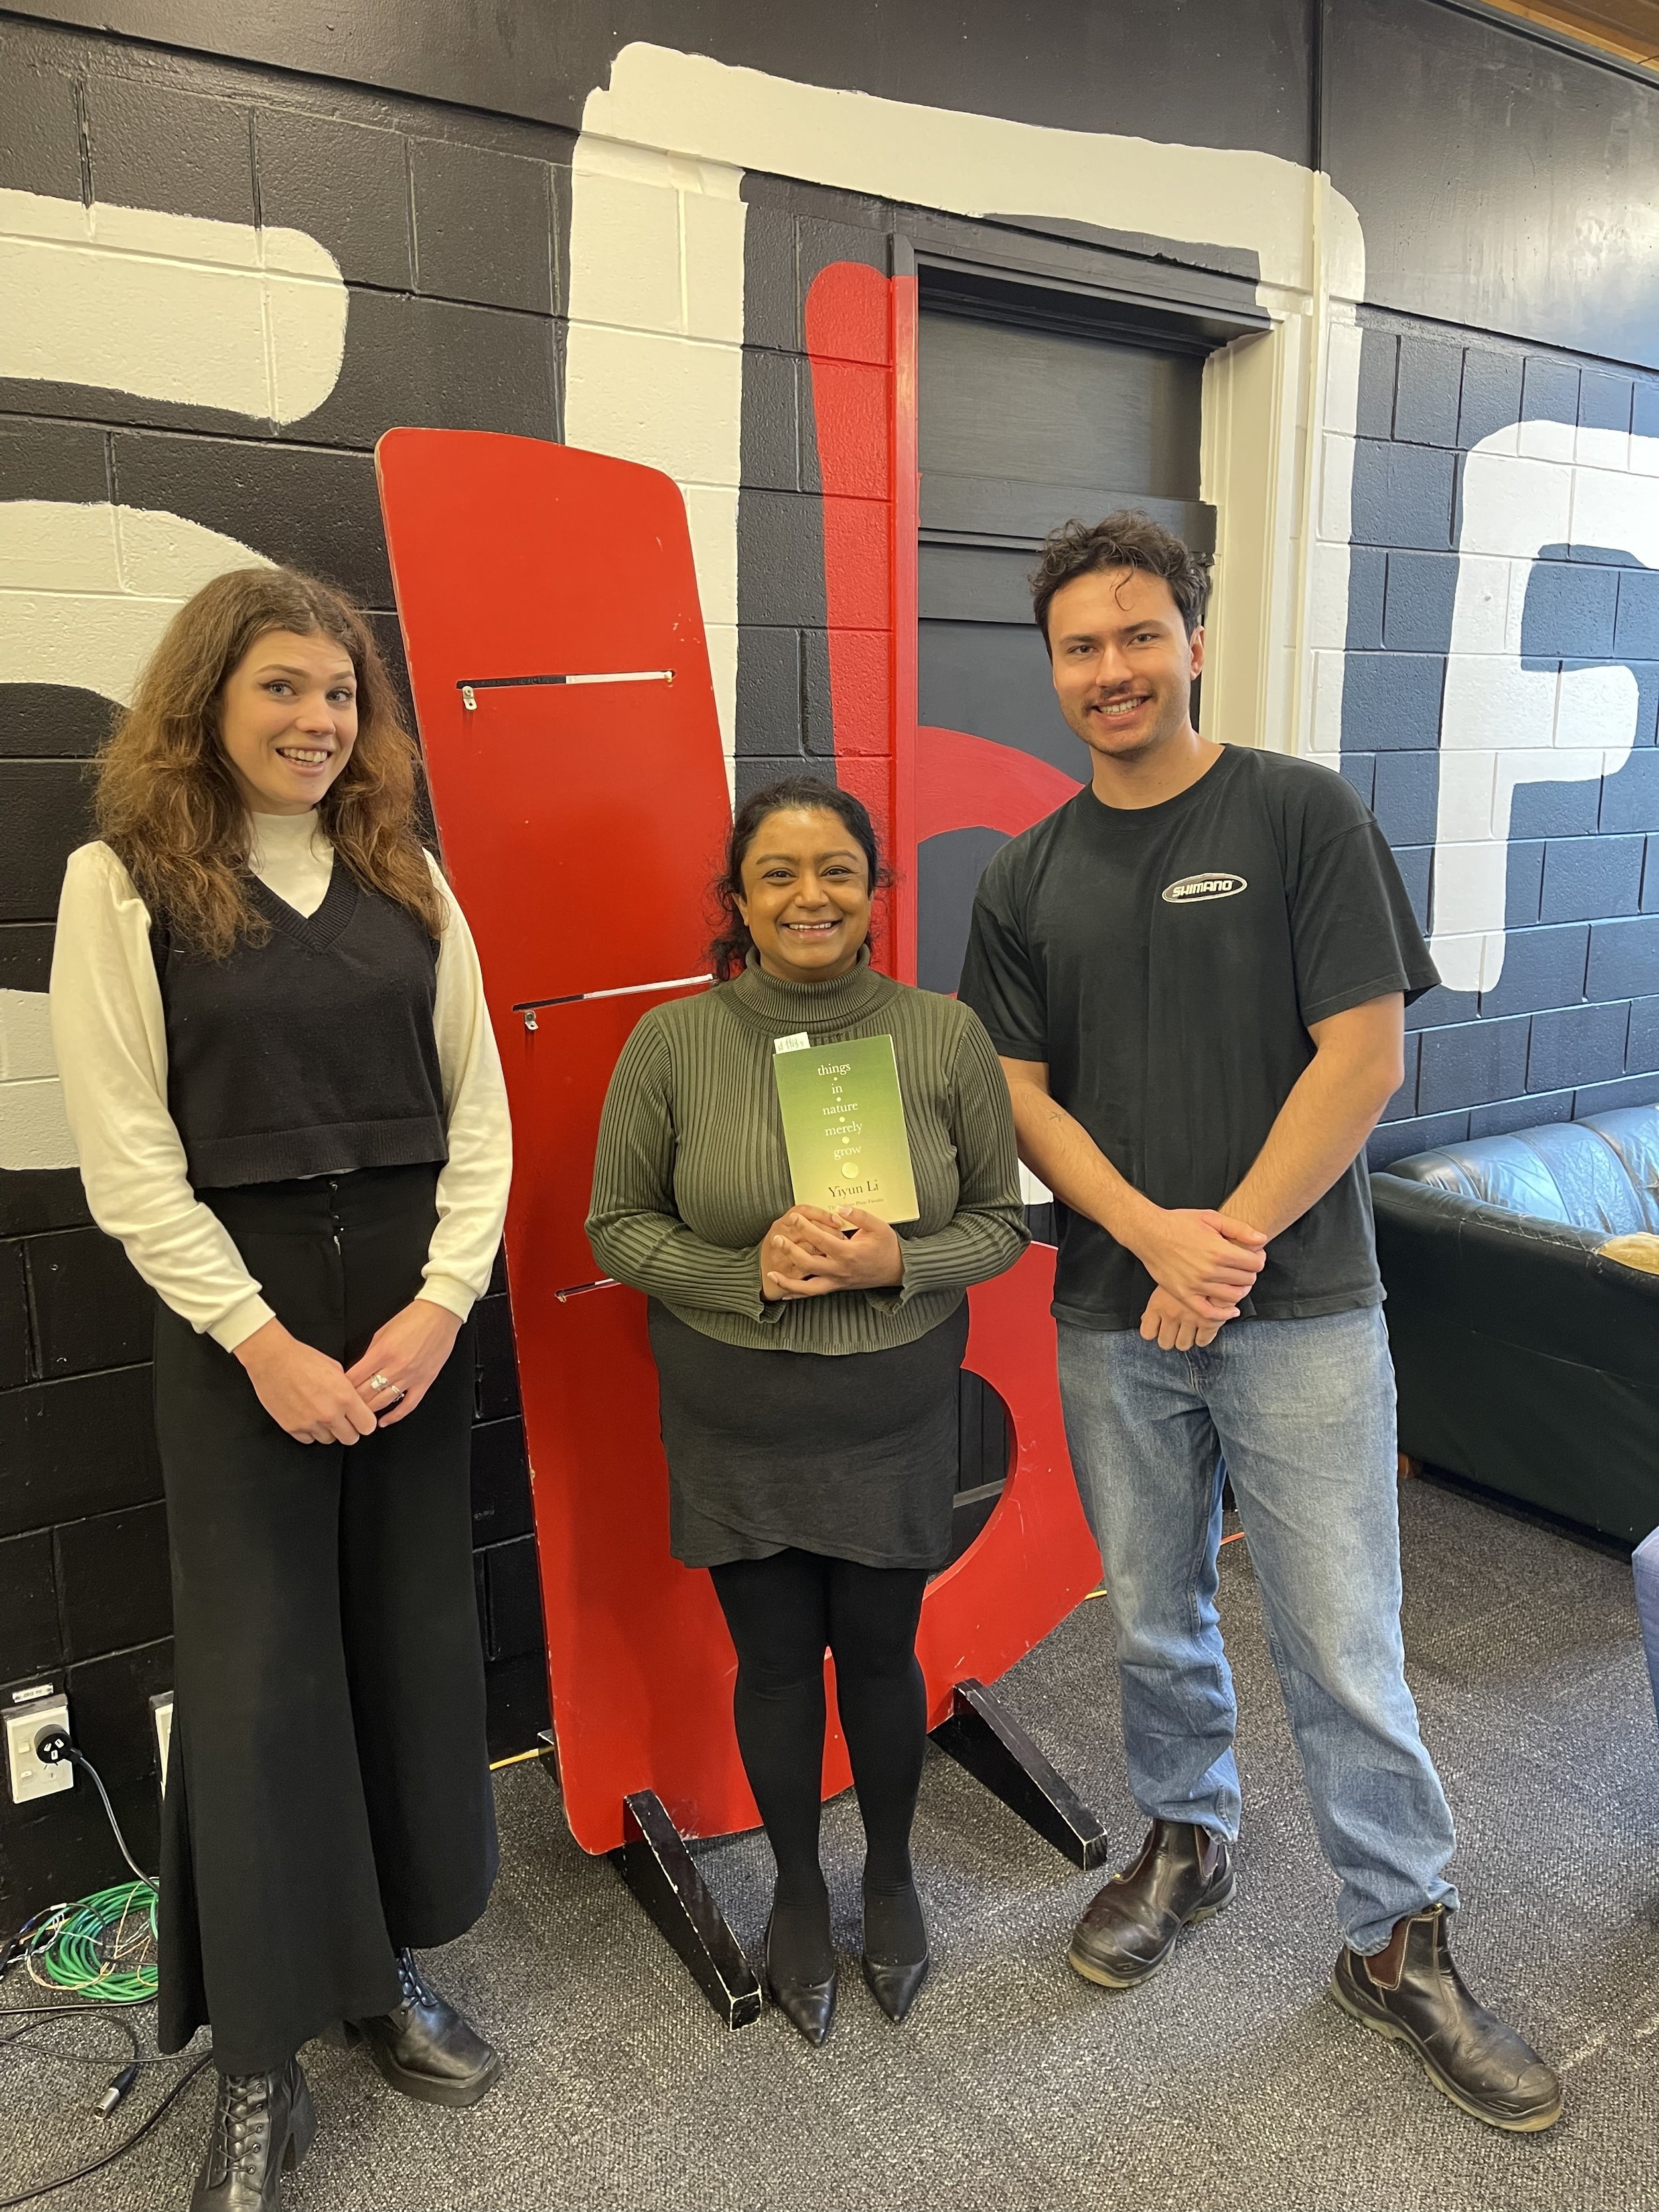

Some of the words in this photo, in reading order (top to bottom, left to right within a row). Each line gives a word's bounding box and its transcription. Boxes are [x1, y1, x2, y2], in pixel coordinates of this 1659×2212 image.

[1172, 880, 1233, 898] SHIMANO
[817, 1063, 851, 1076] things
[831, 1084, 843, 1094] in
[822, 1103, 859, 1116] nature
[825, 1122, 863, 1136] merely
[833, 1146, 861, 1159] grow
[828, 1185, 863, 1199] Yiyun
[867, 1179, 879, 1191] Li
